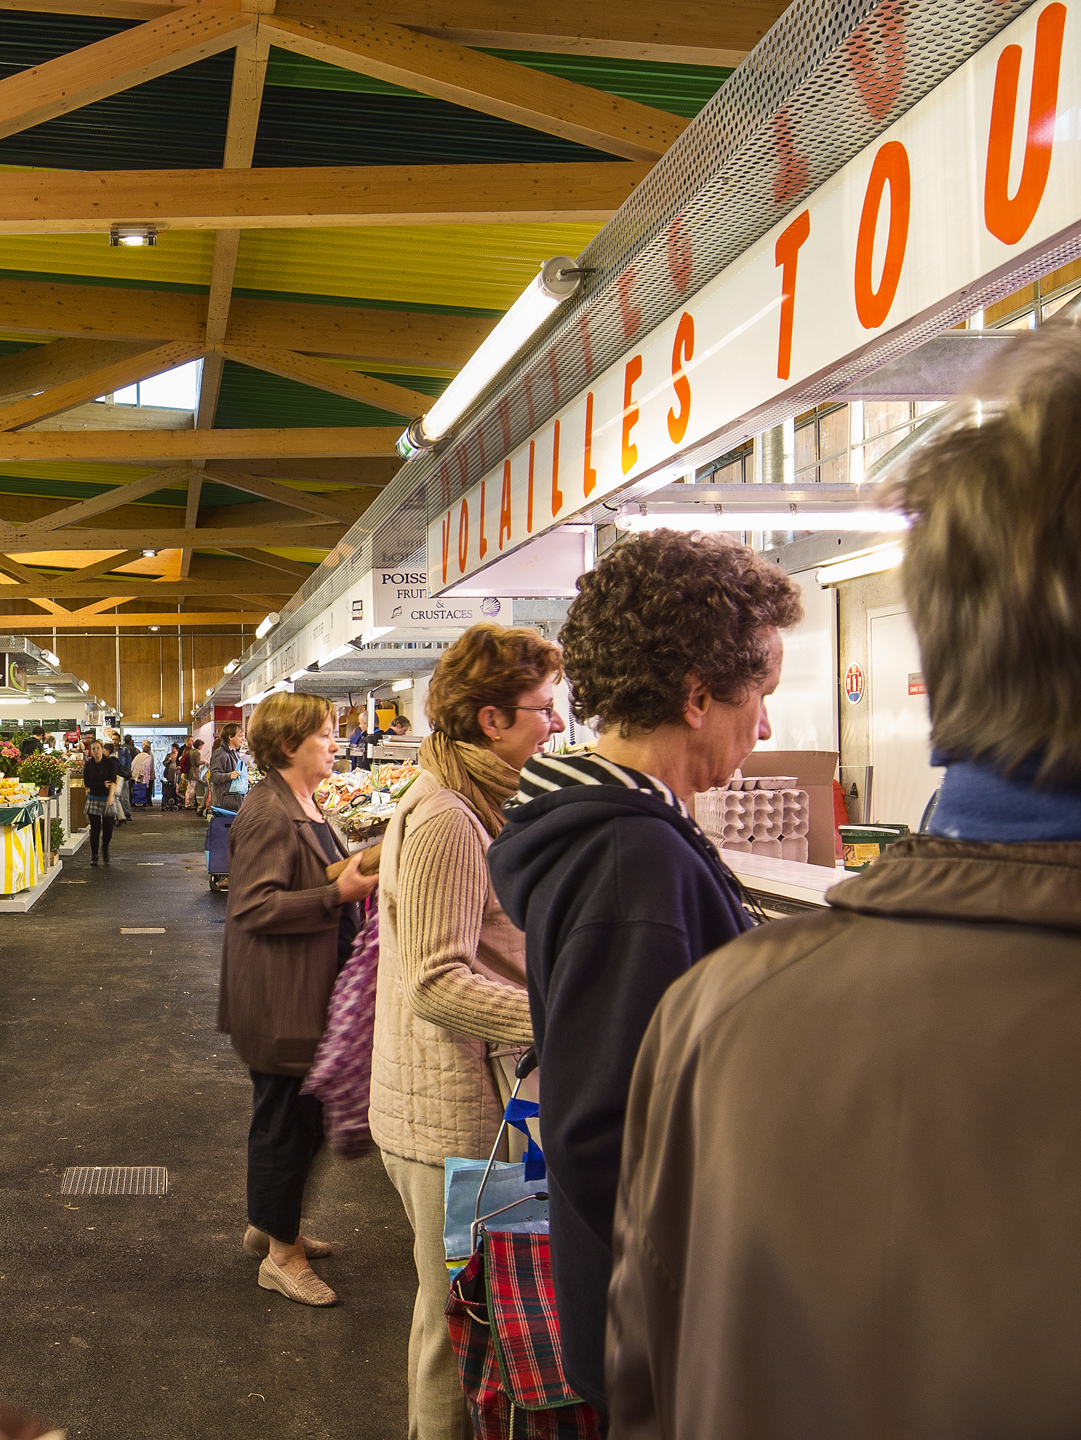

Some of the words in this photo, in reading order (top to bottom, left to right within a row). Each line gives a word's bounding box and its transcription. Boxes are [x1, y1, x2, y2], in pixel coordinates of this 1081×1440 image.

[441, 311, 695, 585] VOLAILLES
[774, 1, 1067, 381] TOU
[435, 599, 445, 608] &
[410, 609, 473, 620] CRUSTACES
